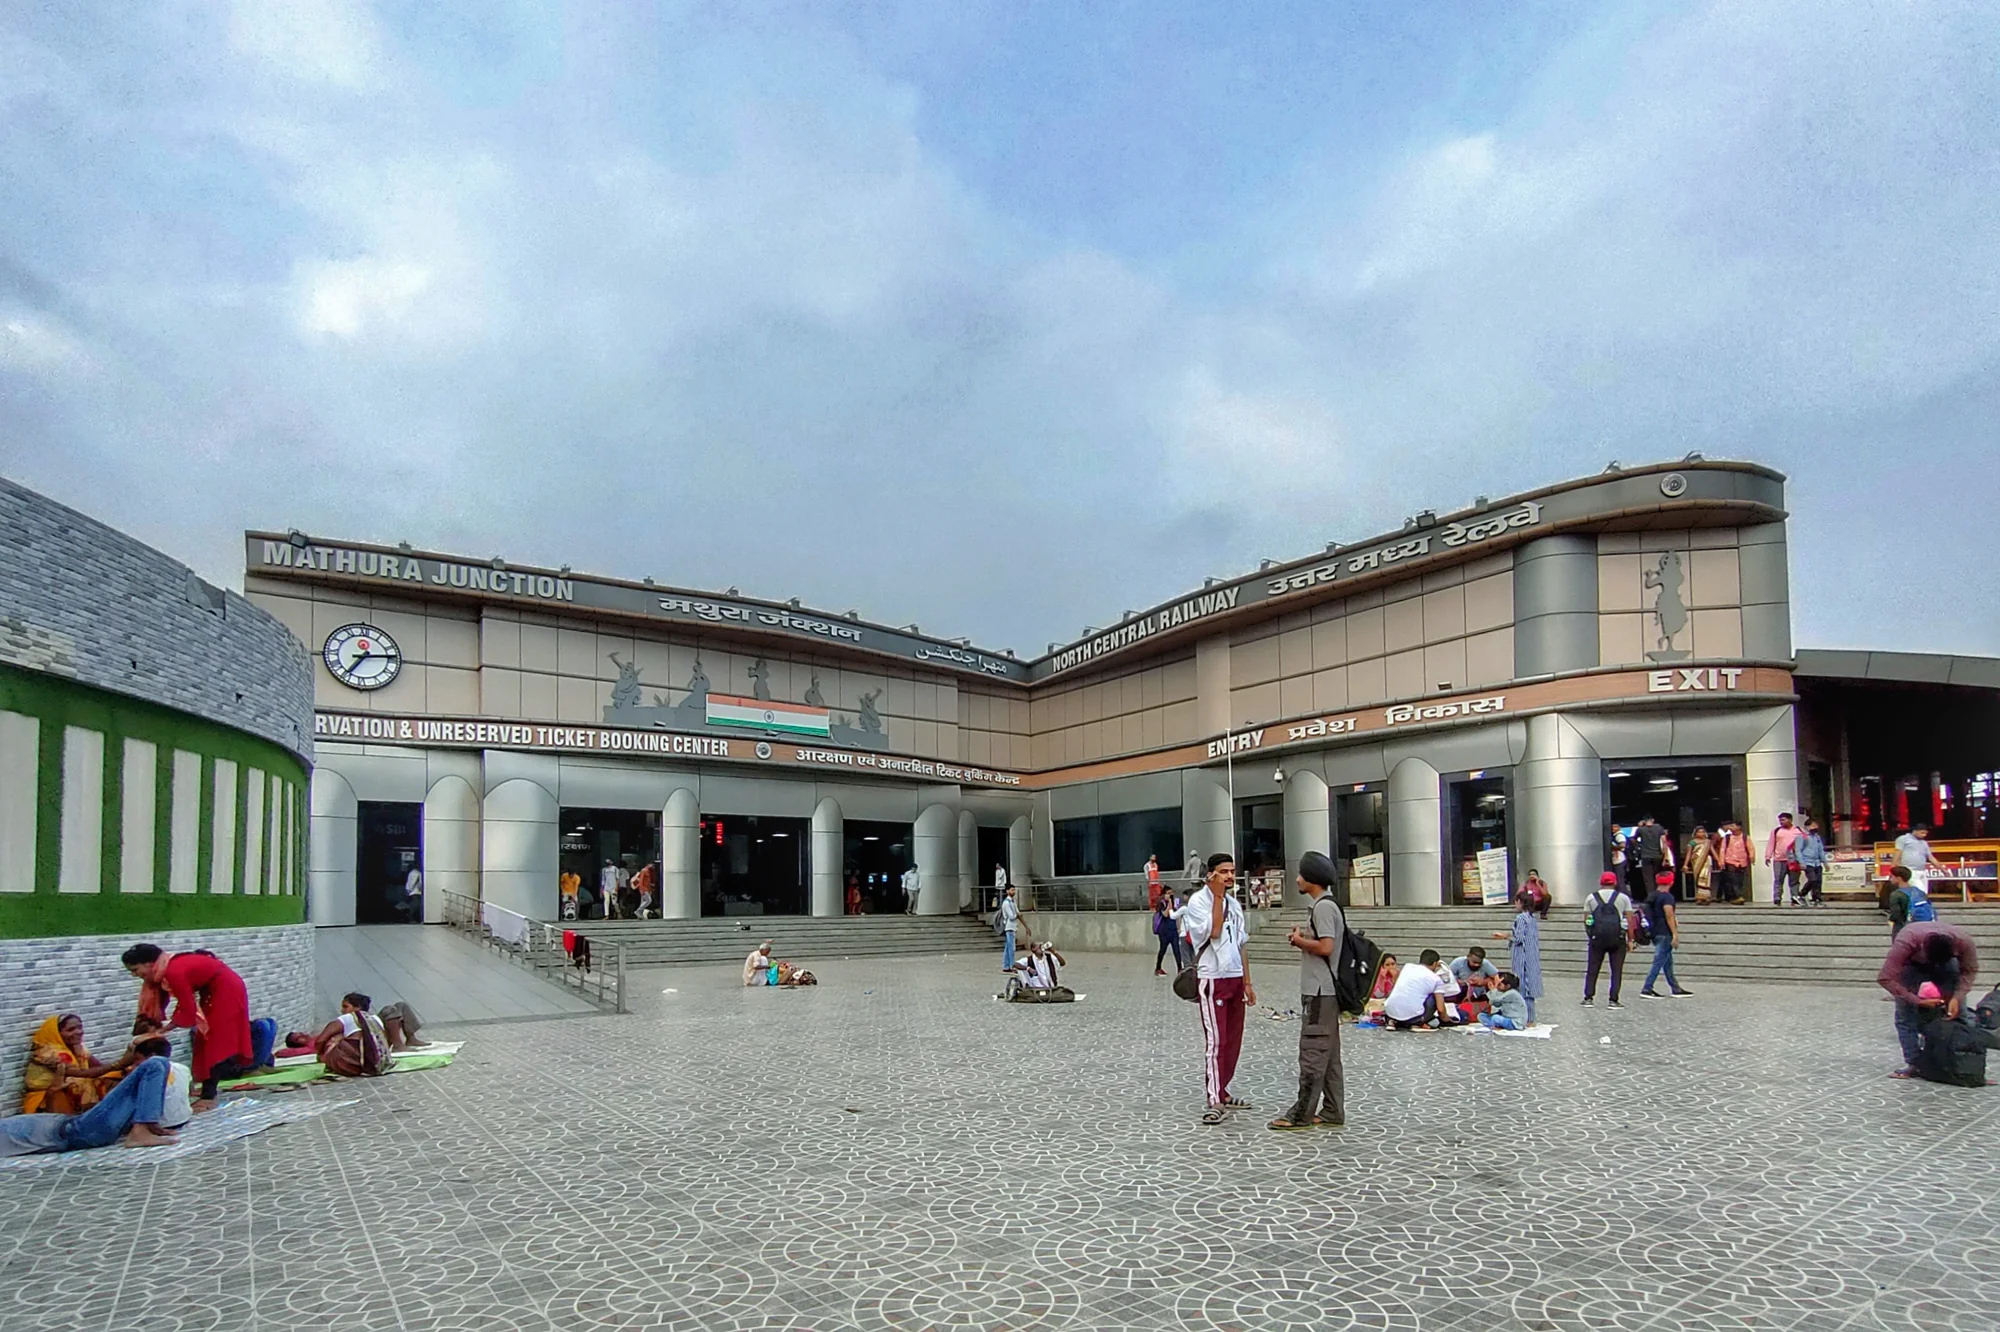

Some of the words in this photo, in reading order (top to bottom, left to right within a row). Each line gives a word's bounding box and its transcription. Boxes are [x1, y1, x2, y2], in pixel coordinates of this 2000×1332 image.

[1266, 562, 1340, 596] उत्तर
[1347, 535, 1433, 573] मध्य
[1441, 501, 1545, 547] रेलवे
[263, 541, 423, 583] MATHURA
[431, 562, 575, 601] JUNCTION
[658, 597, 753, 622] मथुरा
[756, 609, 863, 643] जंक्शन
[1052, 645, 1093, 673] NORTH
[1094, 616, 1156, 656] CENTRAL
[1159, 586, 1240, 631] RAILWAY
[1648, 667, 1742, 692] EXIT
[1287, 717, 1358, 741] प्रवेश
[1384, 695, 1507, 726] निकास
[315, 714, 395, 738] RVATION
[400, 720, 413, 738] &
[418, 720, 532, 745] UNRESERVED
[537, 727, 597, 748] TICKET
[600, 731, 670, 753] BOOKING
[673, 736, 729, 757] CENTER
[1207, 729, 1265, 758] ENTRY
[796, 749, 853, 765] आरक्षण
[857, 754, 876, 766] एवं
[878, 758, 934, 775] अनारक्षित
[936, 763, 962, 779] टिकट
[964, 768, 993, 782] बुकिंग
